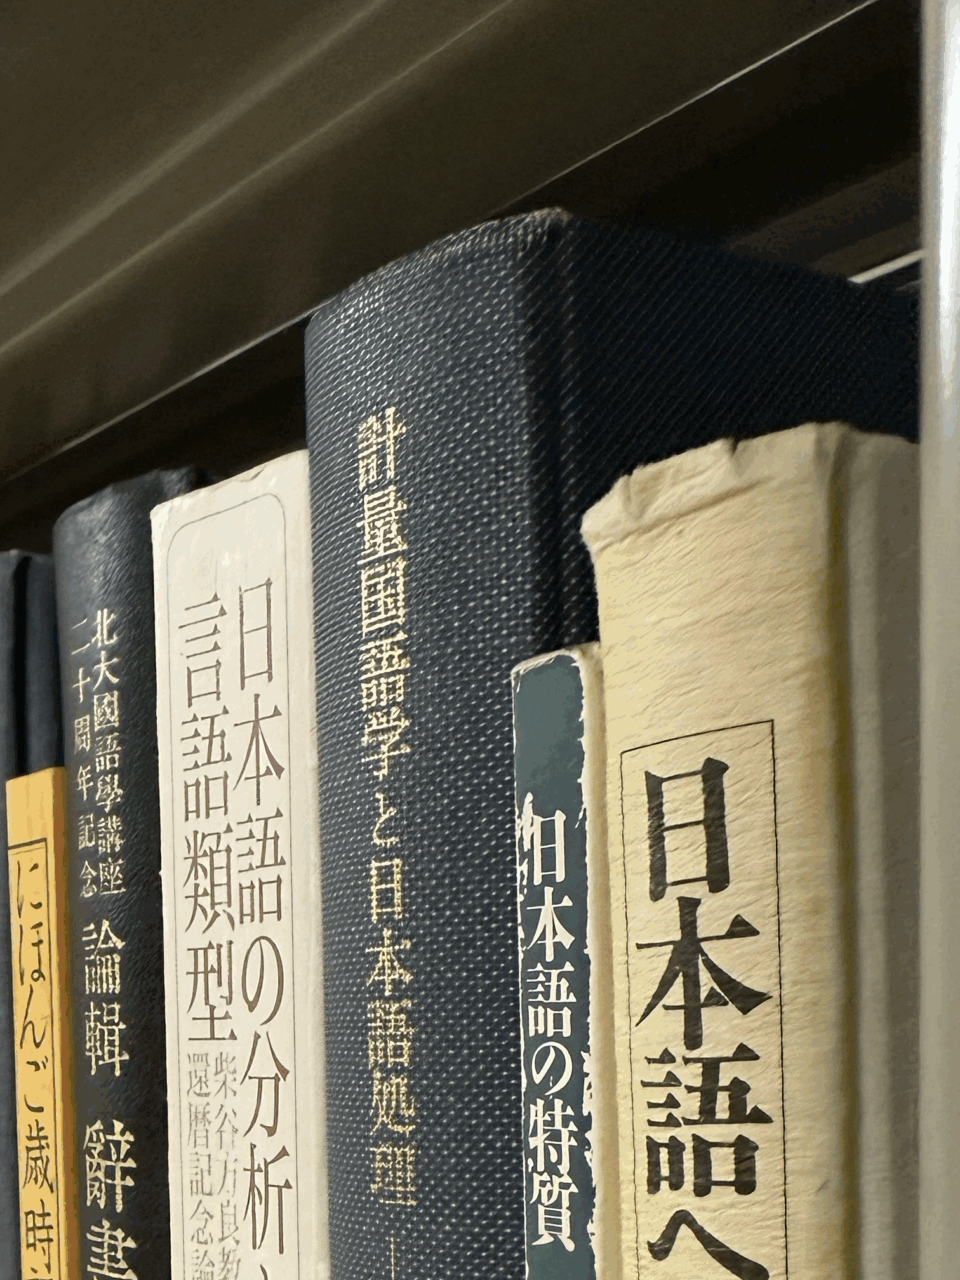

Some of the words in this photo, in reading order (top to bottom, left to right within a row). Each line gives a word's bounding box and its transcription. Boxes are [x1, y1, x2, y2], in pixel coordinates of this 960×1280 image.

[178, 592, 238, 1042] 言語類型
[526, 809, 580, 1252] 日本語の特質
